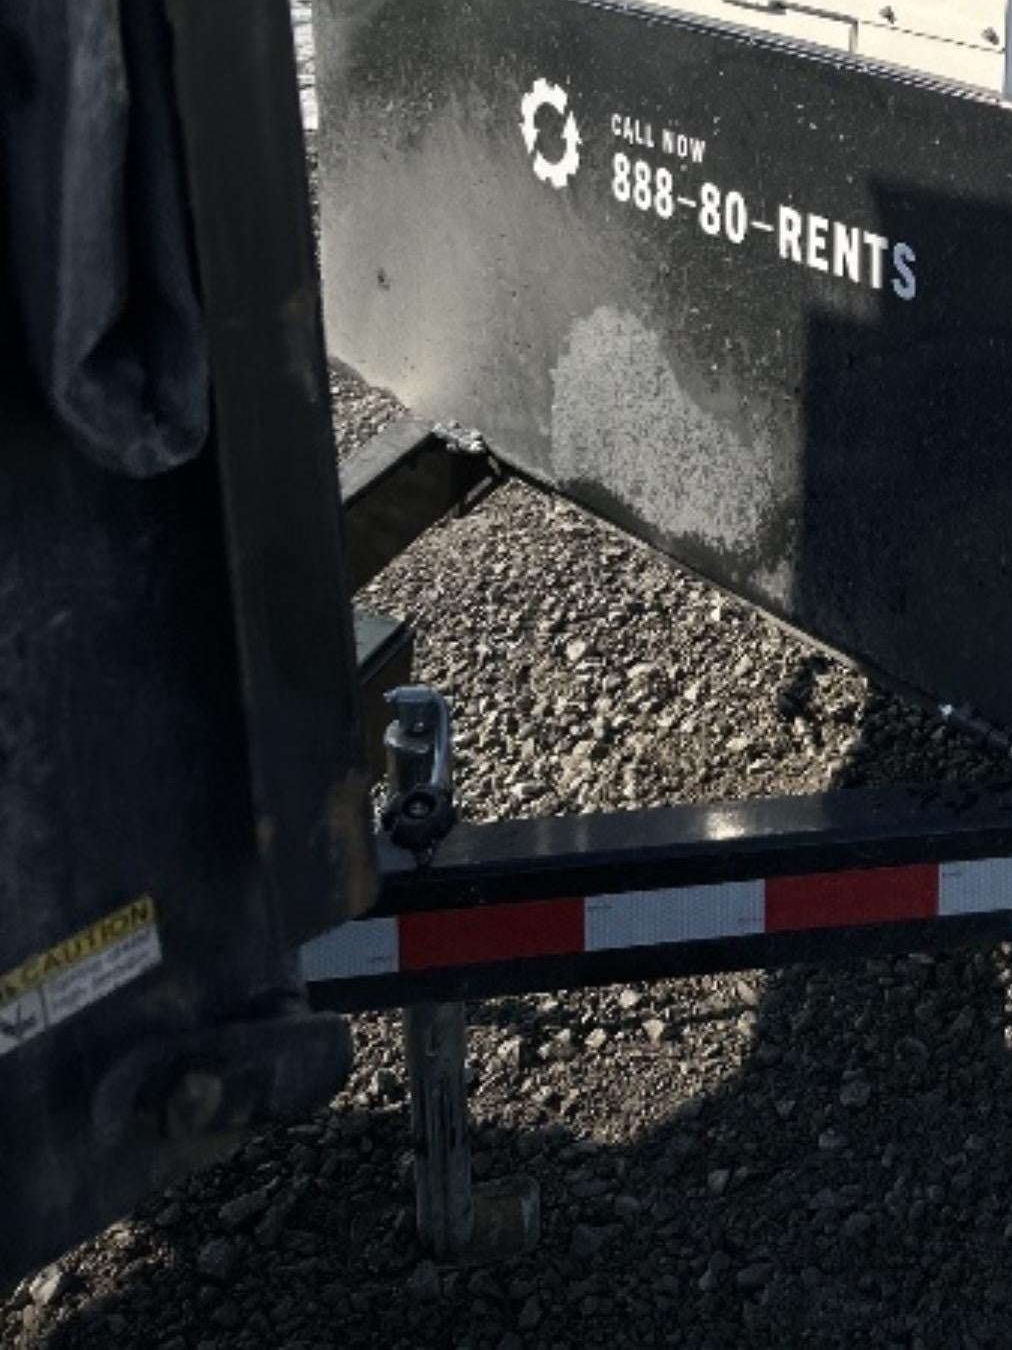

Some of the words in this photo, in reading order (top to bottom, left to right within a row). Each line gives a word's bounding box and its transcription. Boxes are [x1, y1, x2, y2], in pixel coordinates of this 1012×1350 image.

[611, 113, 655, 148] CALL
[663, 128, 707, 163] NOW
[611, 151, 917, 301] 888-80-RENTS
[21, 902, 149, 983] CAUTION
